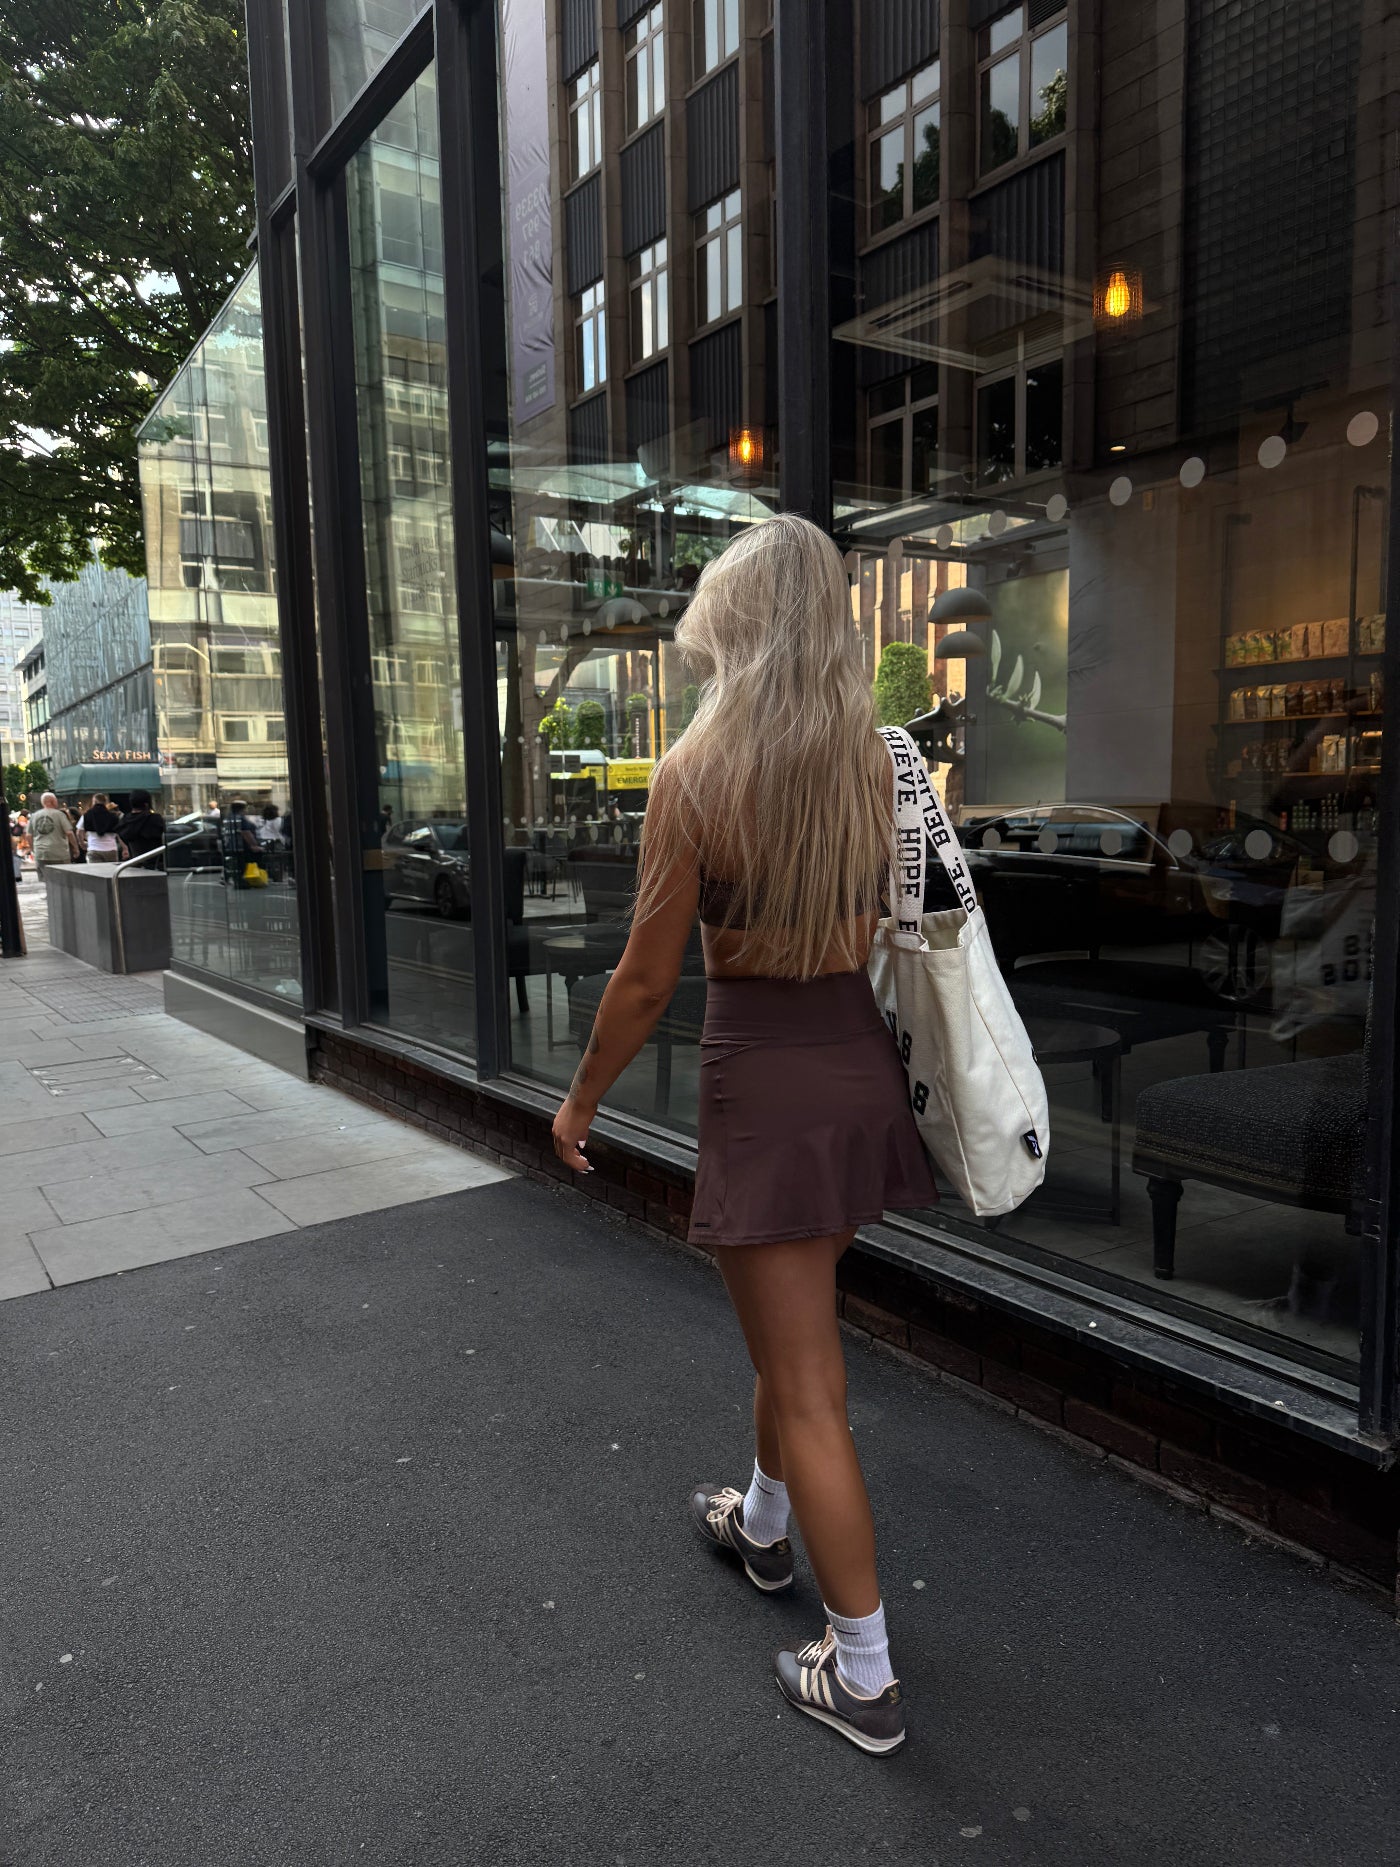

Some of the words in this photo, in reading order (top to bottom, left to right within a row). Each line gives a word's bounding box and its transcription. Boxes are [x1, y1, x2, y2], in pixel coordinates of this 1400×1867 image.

[93, 749, 120, 760] SEXY
[125, 750, 151, 760] FISH
[879, 728, 918, 812] HIEVE.
[948, 856, 976, 914] OPE.
